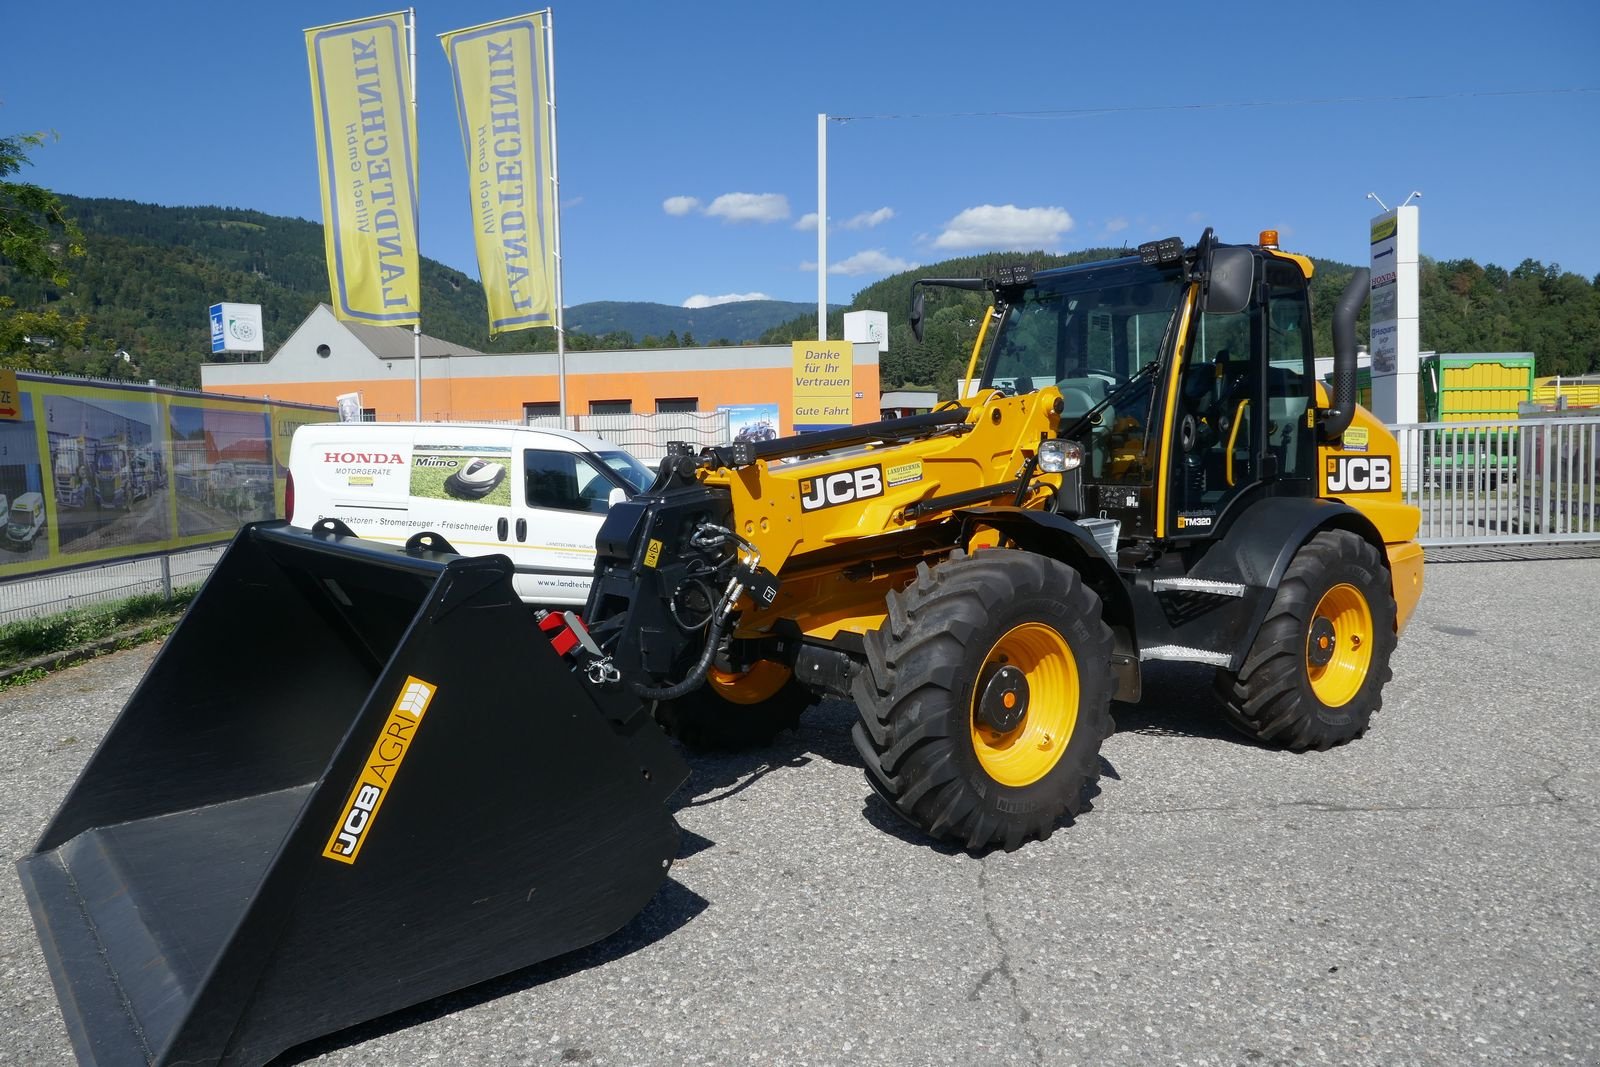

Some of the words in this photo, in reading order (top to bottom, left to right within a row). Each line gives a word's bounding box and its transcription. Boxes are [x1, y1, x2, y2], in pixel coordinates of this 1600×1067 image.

[804, 349, 841, 360] Danke
[803, 363, 820, 373] für
[823, 363, 840, 373] Ihr
[795, 376, 851, 387] Vertrauen
[795, 407, 820, 417] Gute
[823, 406, 850, 417] Fahrt
[323, 452, 404, 465] HONDA
[414, 455, 458, 469] Miimo
[1327, 457, 1391, 492] JCB
[802, 466, 883, 510] JCB
[379, 517, 434, 529] Stromerzeuger
[441, 520, 493, 532] Freischneider
[1184, 516, 1212, 526] TM320
[338, 784, 382, 856] JCB
[369, 713, 416, 784] AGRI
